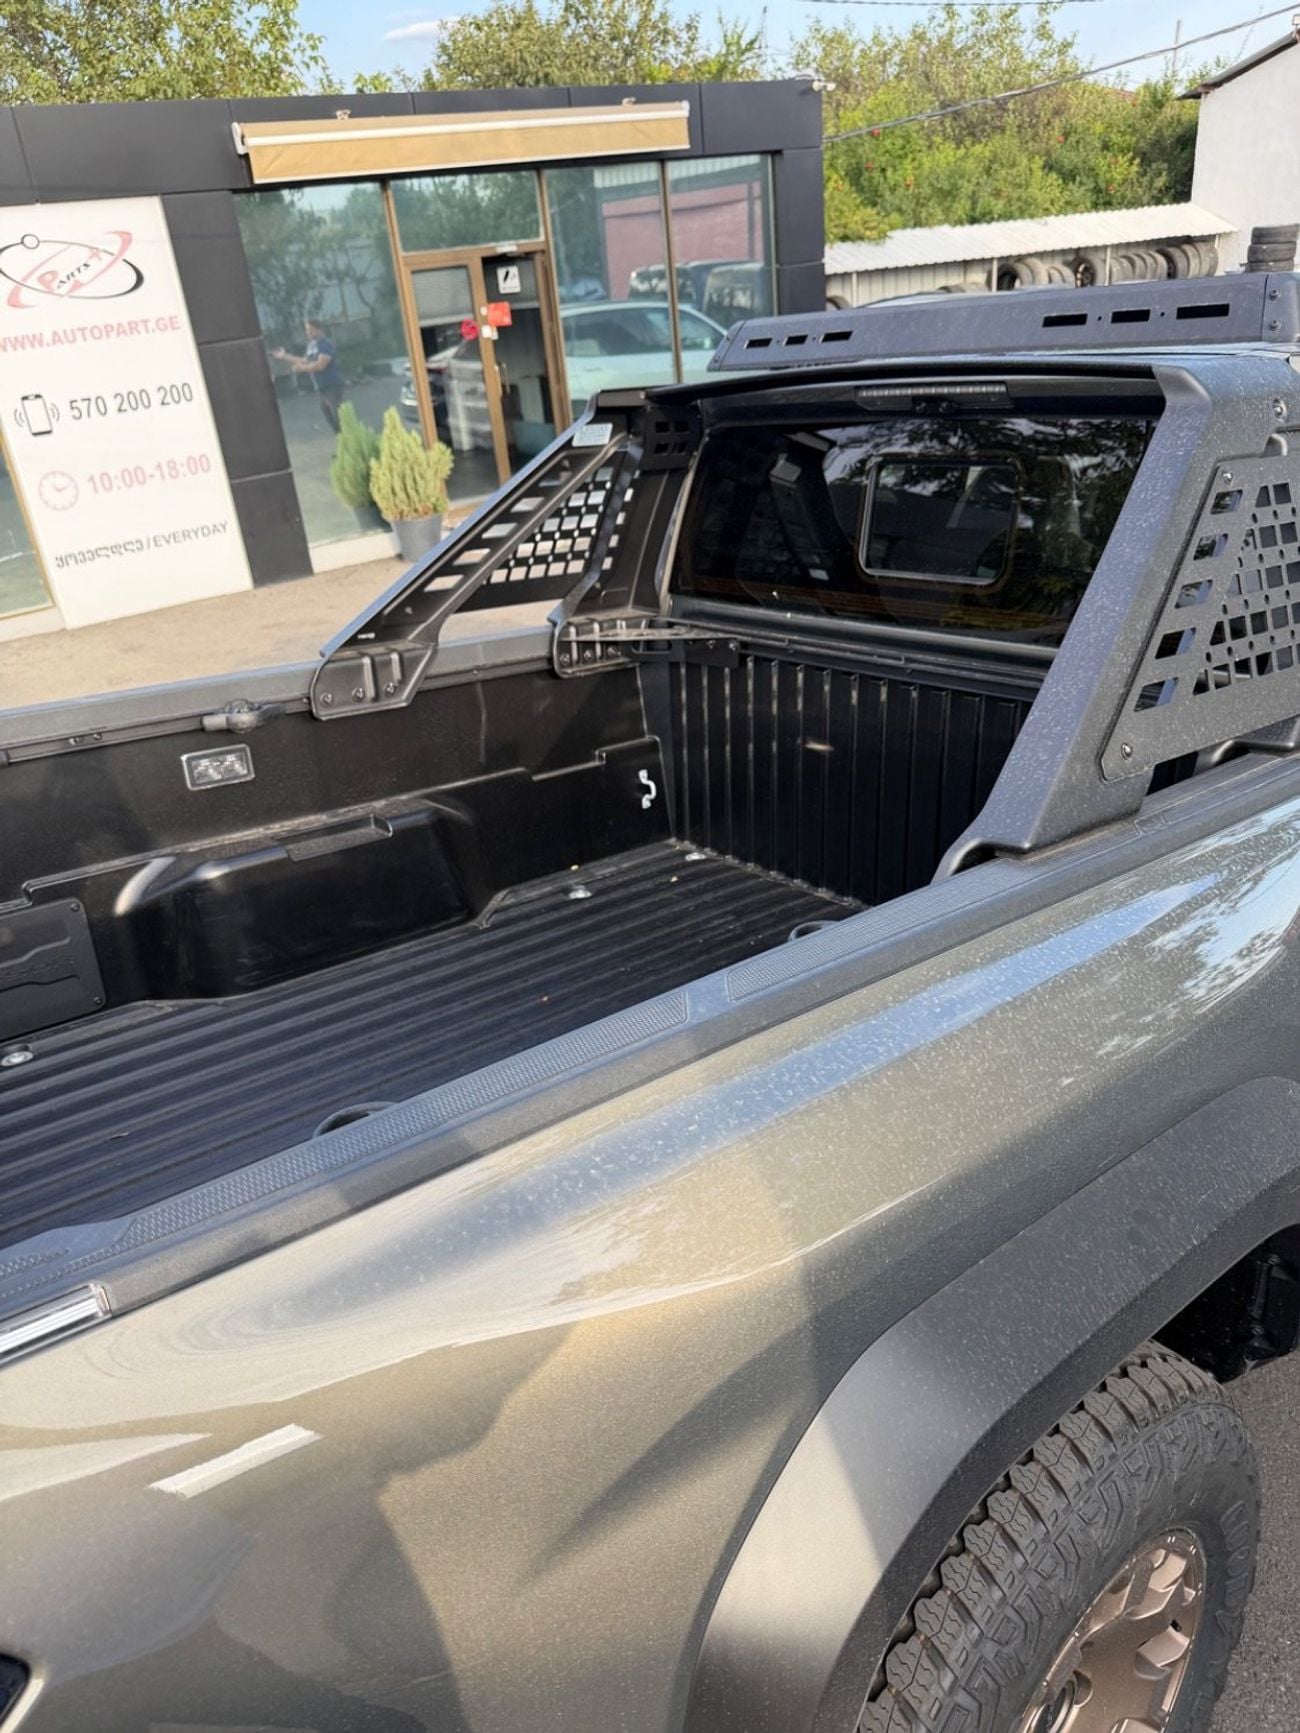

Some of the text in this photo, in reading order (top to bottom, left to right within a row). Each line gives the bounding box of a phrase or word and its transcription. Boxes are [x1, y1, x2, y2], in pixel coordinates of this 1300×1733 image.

[69, 382, 193, 420] 570 200 200
[88, 453, 211, 494] 10:00-18:00
[153, 521, 228, 548] EVERYDAY
